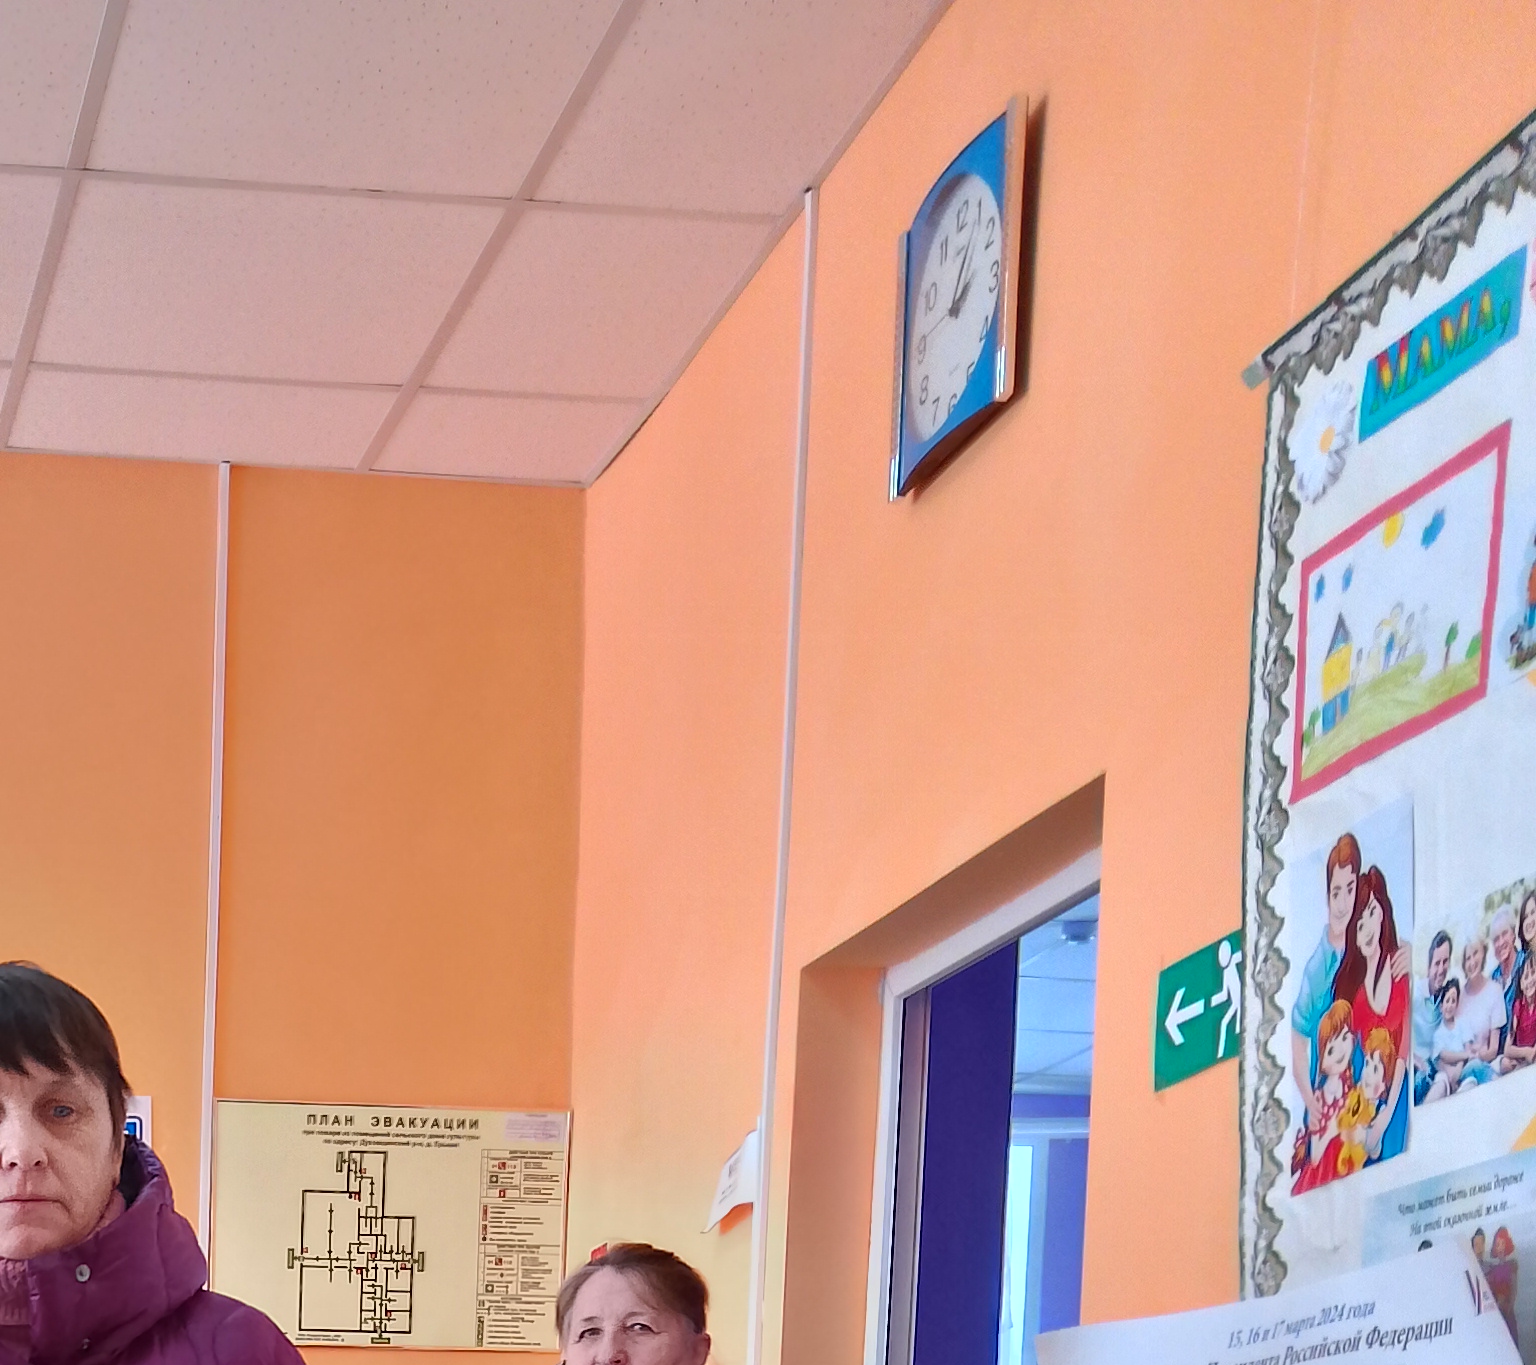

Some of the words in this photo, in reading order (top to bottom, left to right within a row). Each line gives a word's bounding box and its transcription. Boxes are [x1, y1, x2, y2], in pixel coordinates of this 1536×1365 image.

[956, 199, 969, 234] 12
[984, 216, 995, 251] 2
[988, 259, 1000, 293] 3
[919, 374, 929, 406] 8
[932, 396, 941, 428] 7
[306, 1113, 355, 1127] ПЛАН
[370, 1116, 480, 1130] ЭВАКУАЦИИ
[1245, 1325, 1260, 1344] 16
[1283, 1314, 1316, 1338] марта
[1316, 1302, 1346, 1328] 2024
[1346, 1299, 1376, 1321] года
[1364, 1315, 1454, 1352] Федерации
